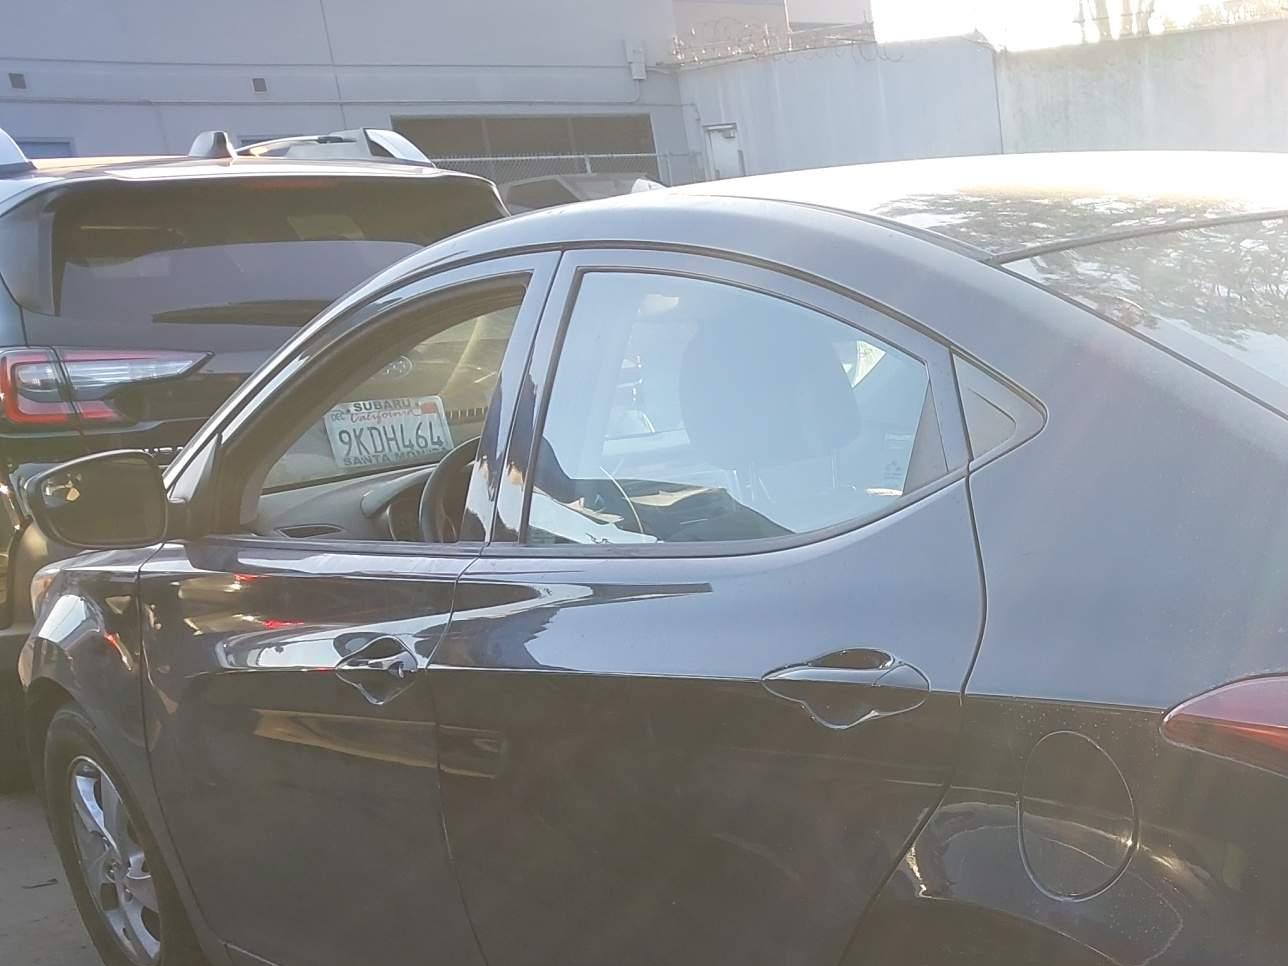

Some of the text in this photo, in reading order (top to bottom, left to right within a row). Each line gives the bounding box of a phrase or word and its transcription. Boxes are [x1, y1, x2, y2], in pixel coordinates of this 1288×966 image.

[353, 399, 411, 412] SUBARU
[338, 421, 444, 456] 9KDH464
[343, 453, 390, 466] SANTA
